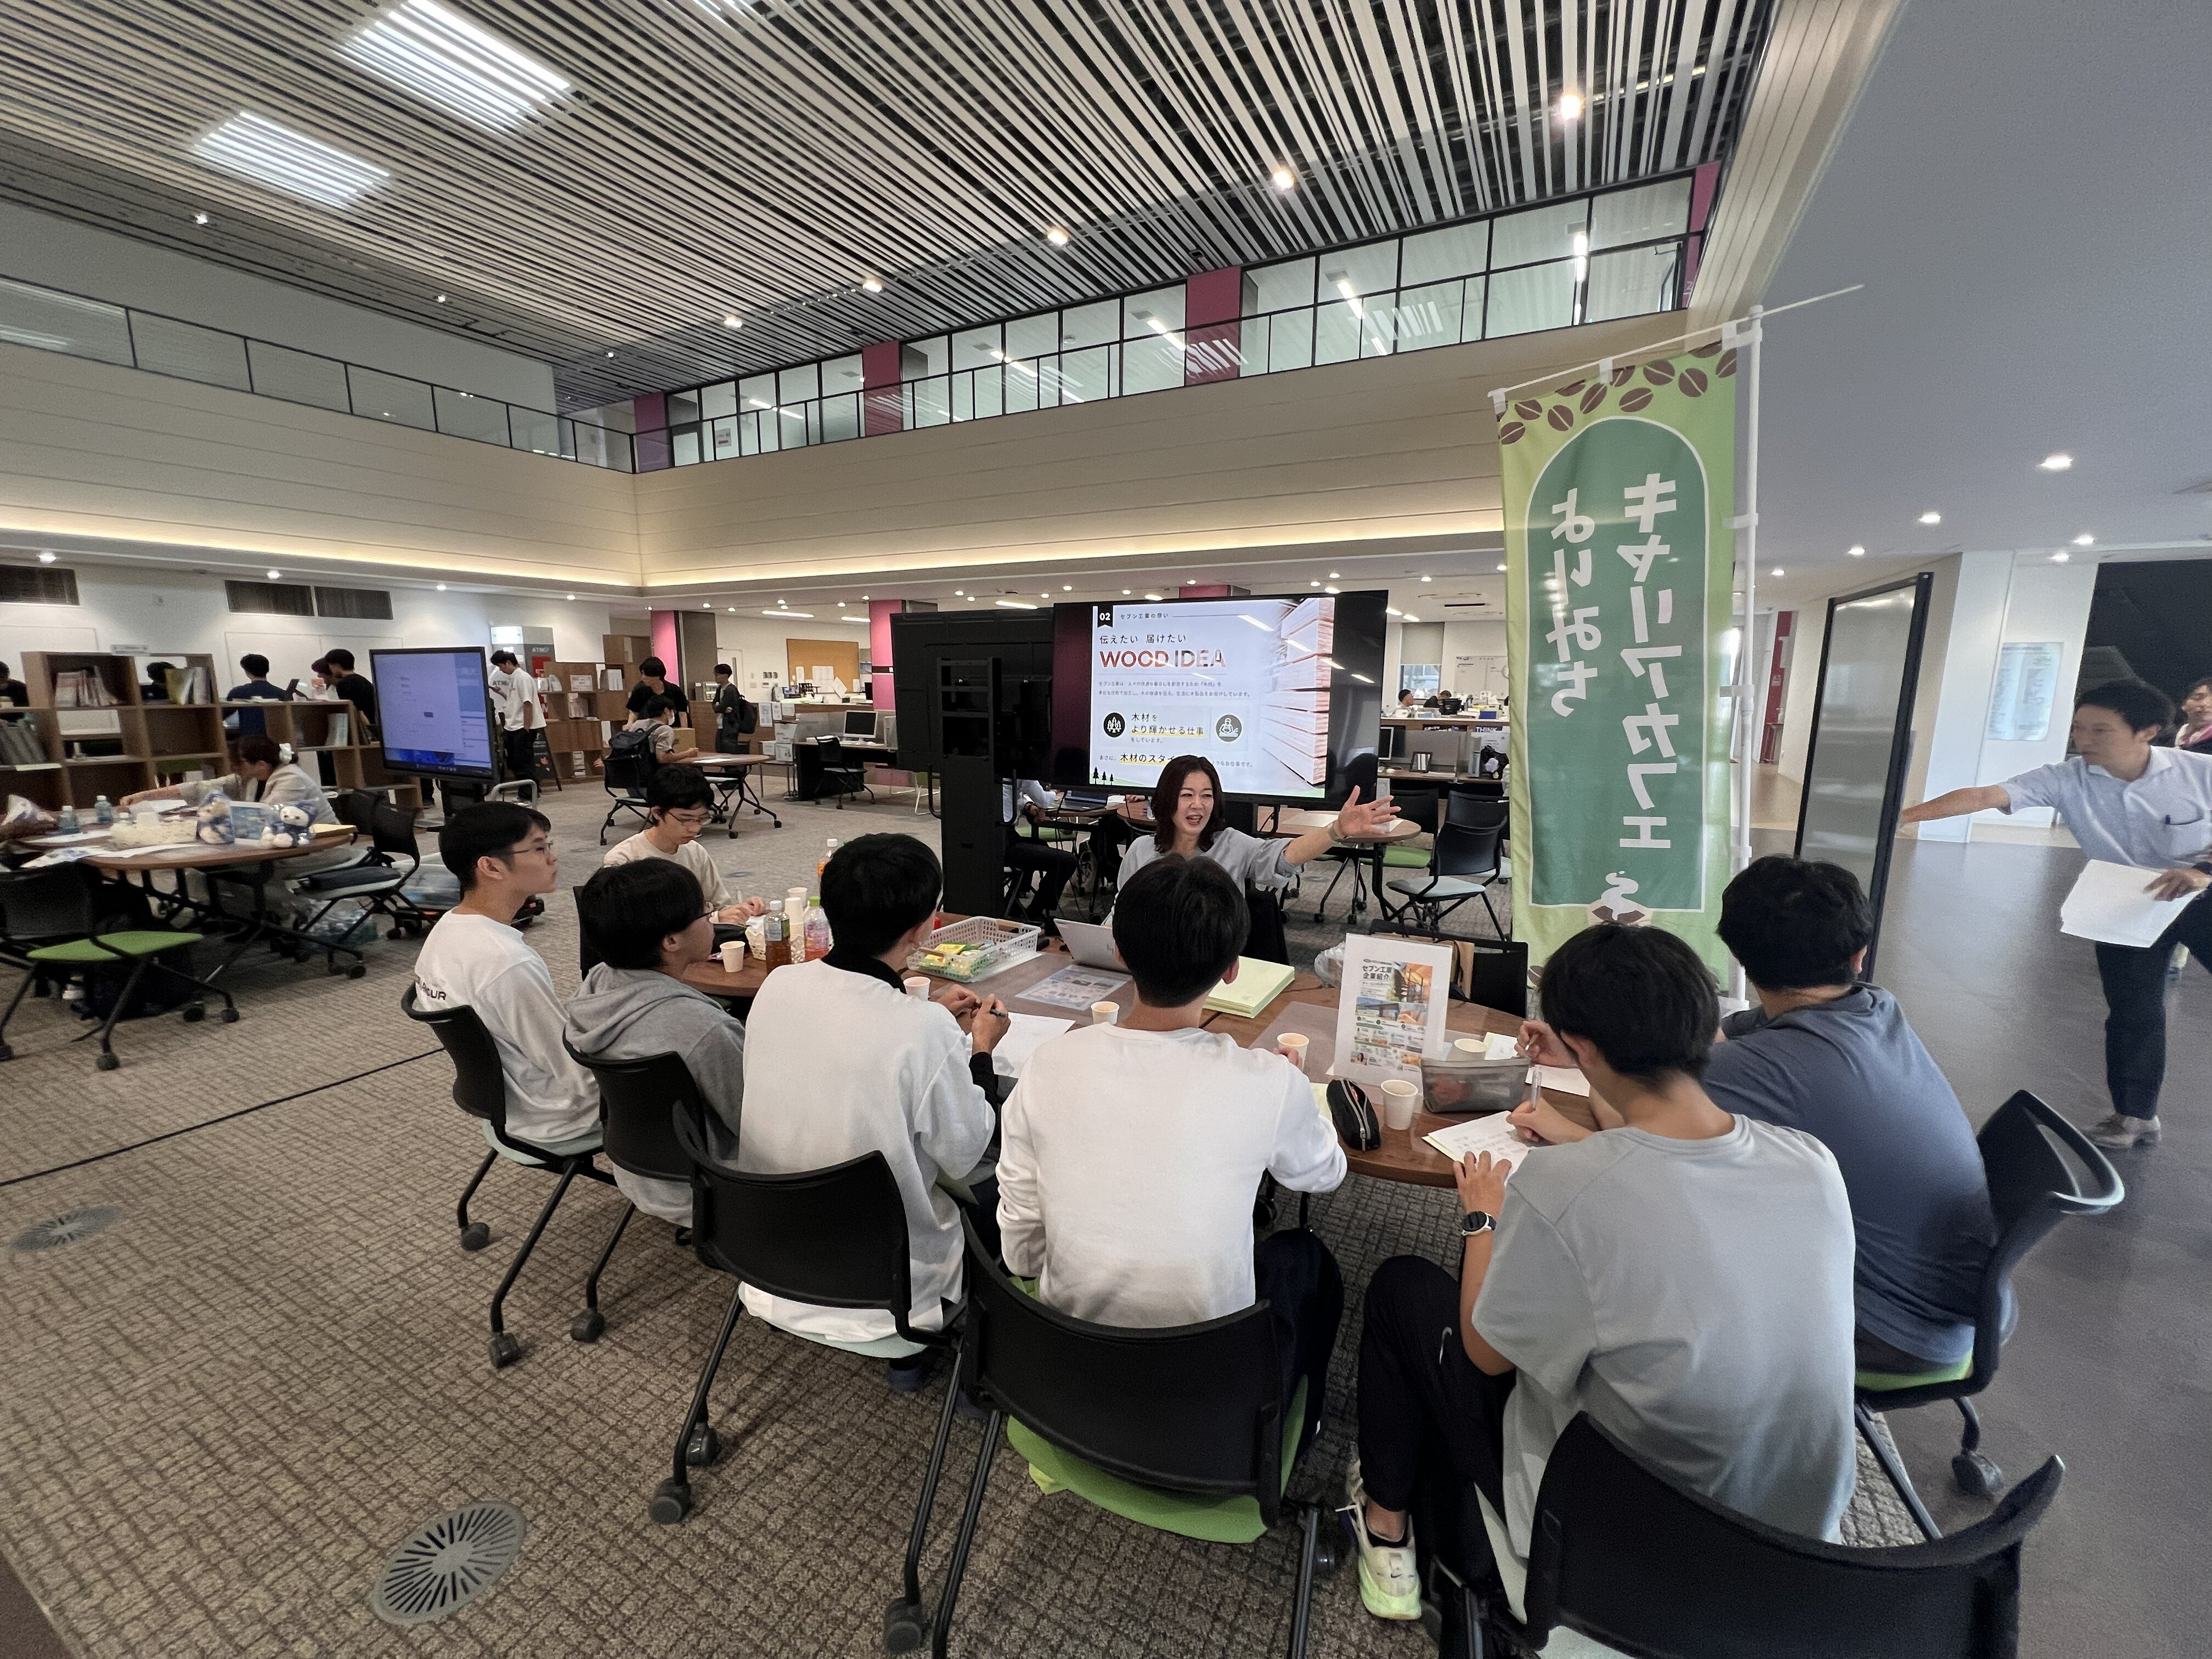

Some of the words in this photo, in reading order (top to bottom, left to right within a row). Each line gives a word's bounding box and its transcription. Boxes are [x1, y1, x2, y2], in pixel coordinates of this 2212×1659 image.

[1099, 612, 1111, 621] 02
[1099, 635, 1138, 644] 伝えたい
[1146, 634, 1187, 644] 届けたい
[1099, 650, 1169, 668] WOOD
[1175, 649, 1226, 668] IDEA
[1131, 712, 1158, 722] 木材を
[1131, 725, 1204, 736] より輝かせる仕事
[1362, 965, 1392, 973] セブン工業
